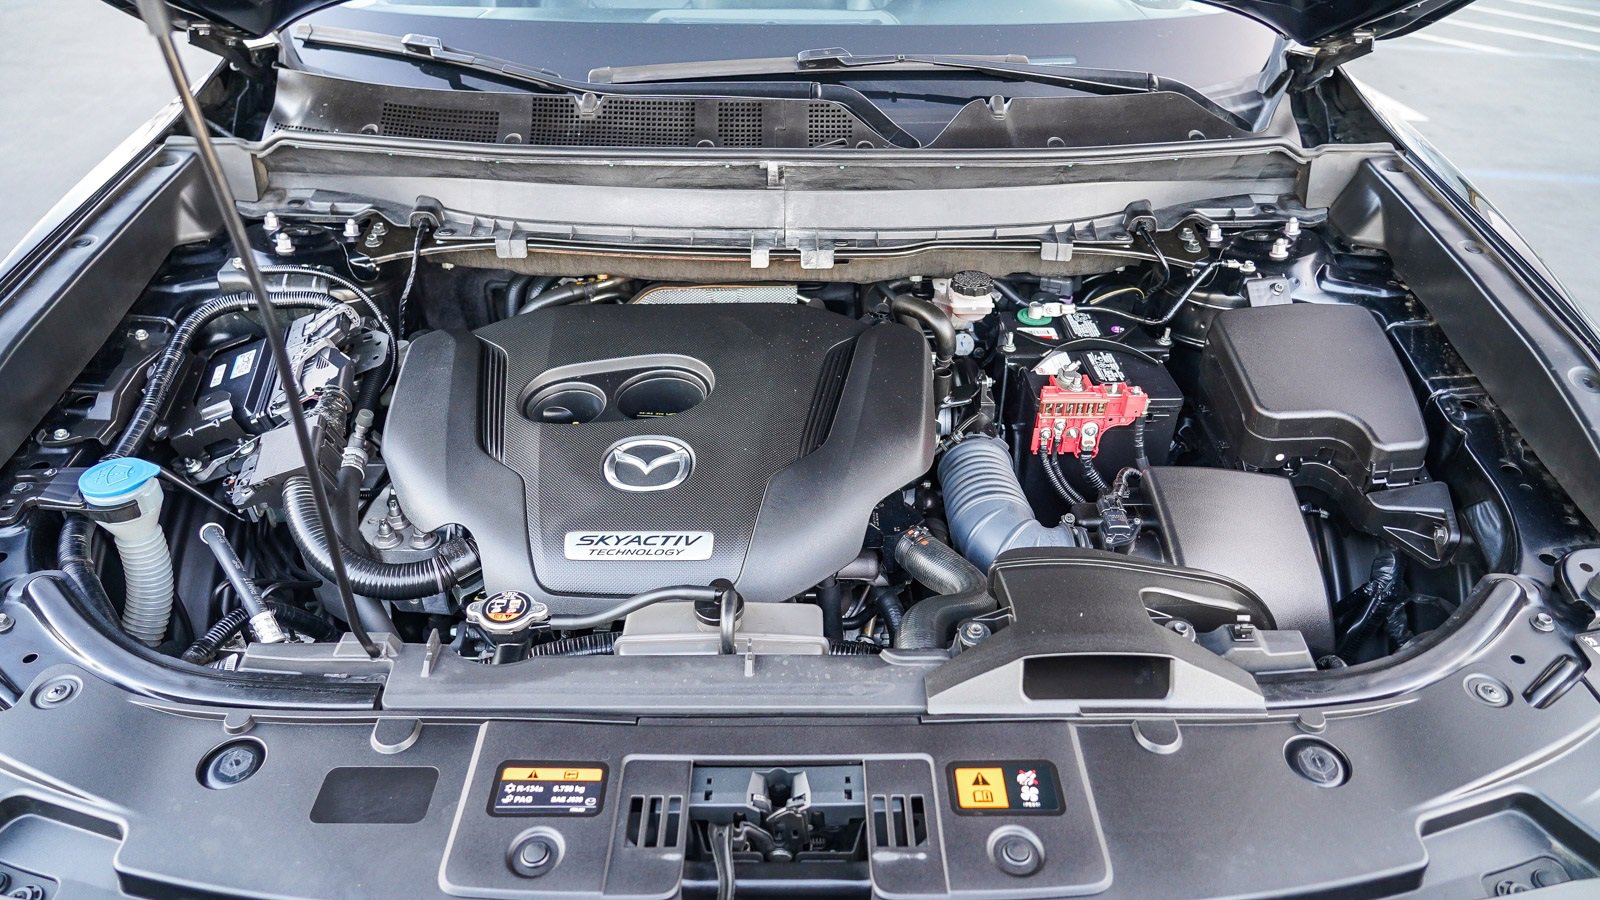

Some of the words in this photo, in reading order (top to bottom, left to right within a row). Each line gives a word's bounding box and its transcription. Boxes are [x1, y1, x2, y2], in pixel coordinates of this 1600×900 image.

[575, 535, 703, 546] SKYACTIV
[516, 784, 544, 793] R-134a
[574, 784, 586, 794] kg
[513, 795, 533, 804] PAG
